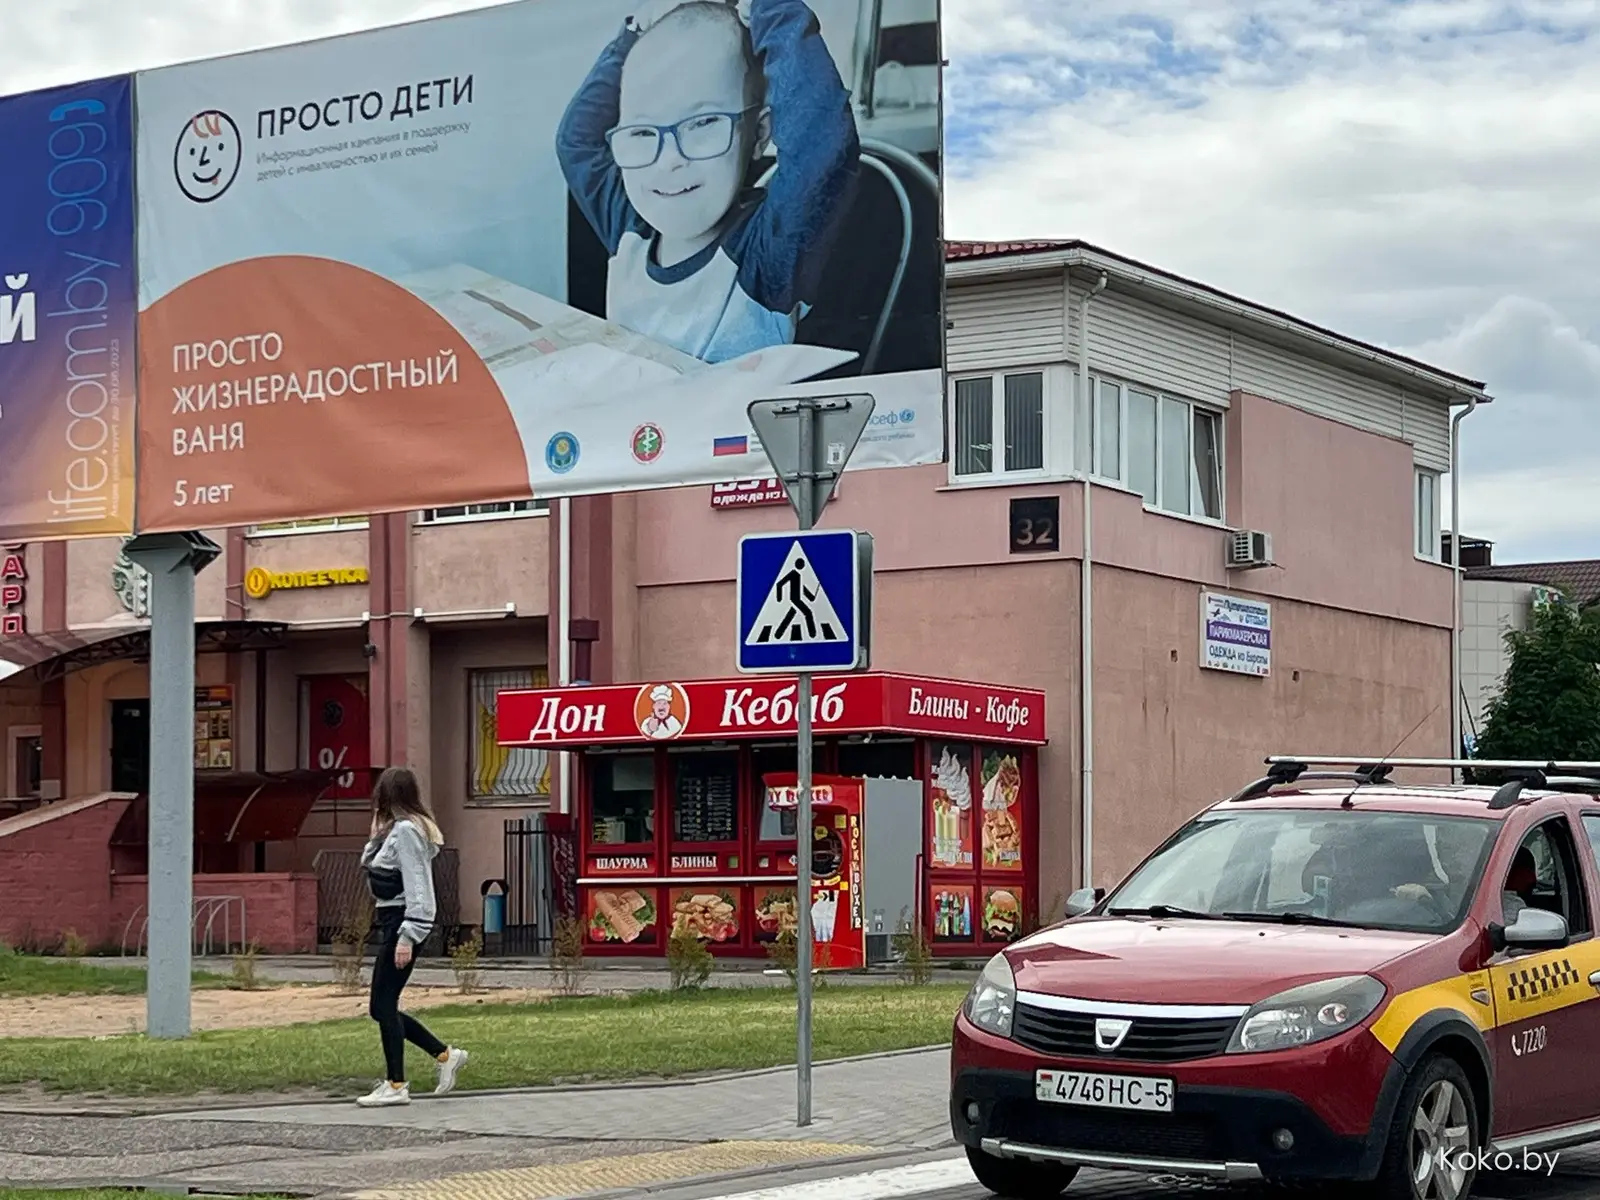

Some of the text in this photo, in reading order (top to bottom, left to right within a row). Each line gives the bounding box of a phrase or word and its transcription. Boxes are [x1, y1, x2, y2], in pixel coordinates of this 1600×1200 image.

[256, 74, 474, 139] ПРОСТО ДЕТИ
[256, 141, 348, 165] Информационная
[411, 122, 471, 140] поддержку
[256, 166, 286, 182] детей
[288, 166, 294, 176] с
[296, 153, 378, 174] инвалидностью
[405, 141, 439, 157] семей
[46, 122, 120, 523] life.com.by 909
[172, 332, 283, 373] ПРОСТО
[171, 348, 459, 414] ЖИЗНЕРАДОСТНЫЙ
[171, 421, 245, 456] ВАНЯ
[173, 480, 234, 506] 5 лет
[1015, 518, 1054, 546] 32
[269, 567, 369, 589] КОПЕЕЧКА
[1209, 624, 1268, 646] ПАРИКМАХЕРСКАЯ
[529, 697, 607, 741] Дон
[908, 687, 969, 720] Блины
[985, 695, 1030, 732] Кофе
[595, 857, 649, 870] ШАУРМА
[671, 856, 718, 869] БЛИНЫ
[852, 872, 863, 929] BOXER
[1522, 1025, 1547, 1054] 7220
